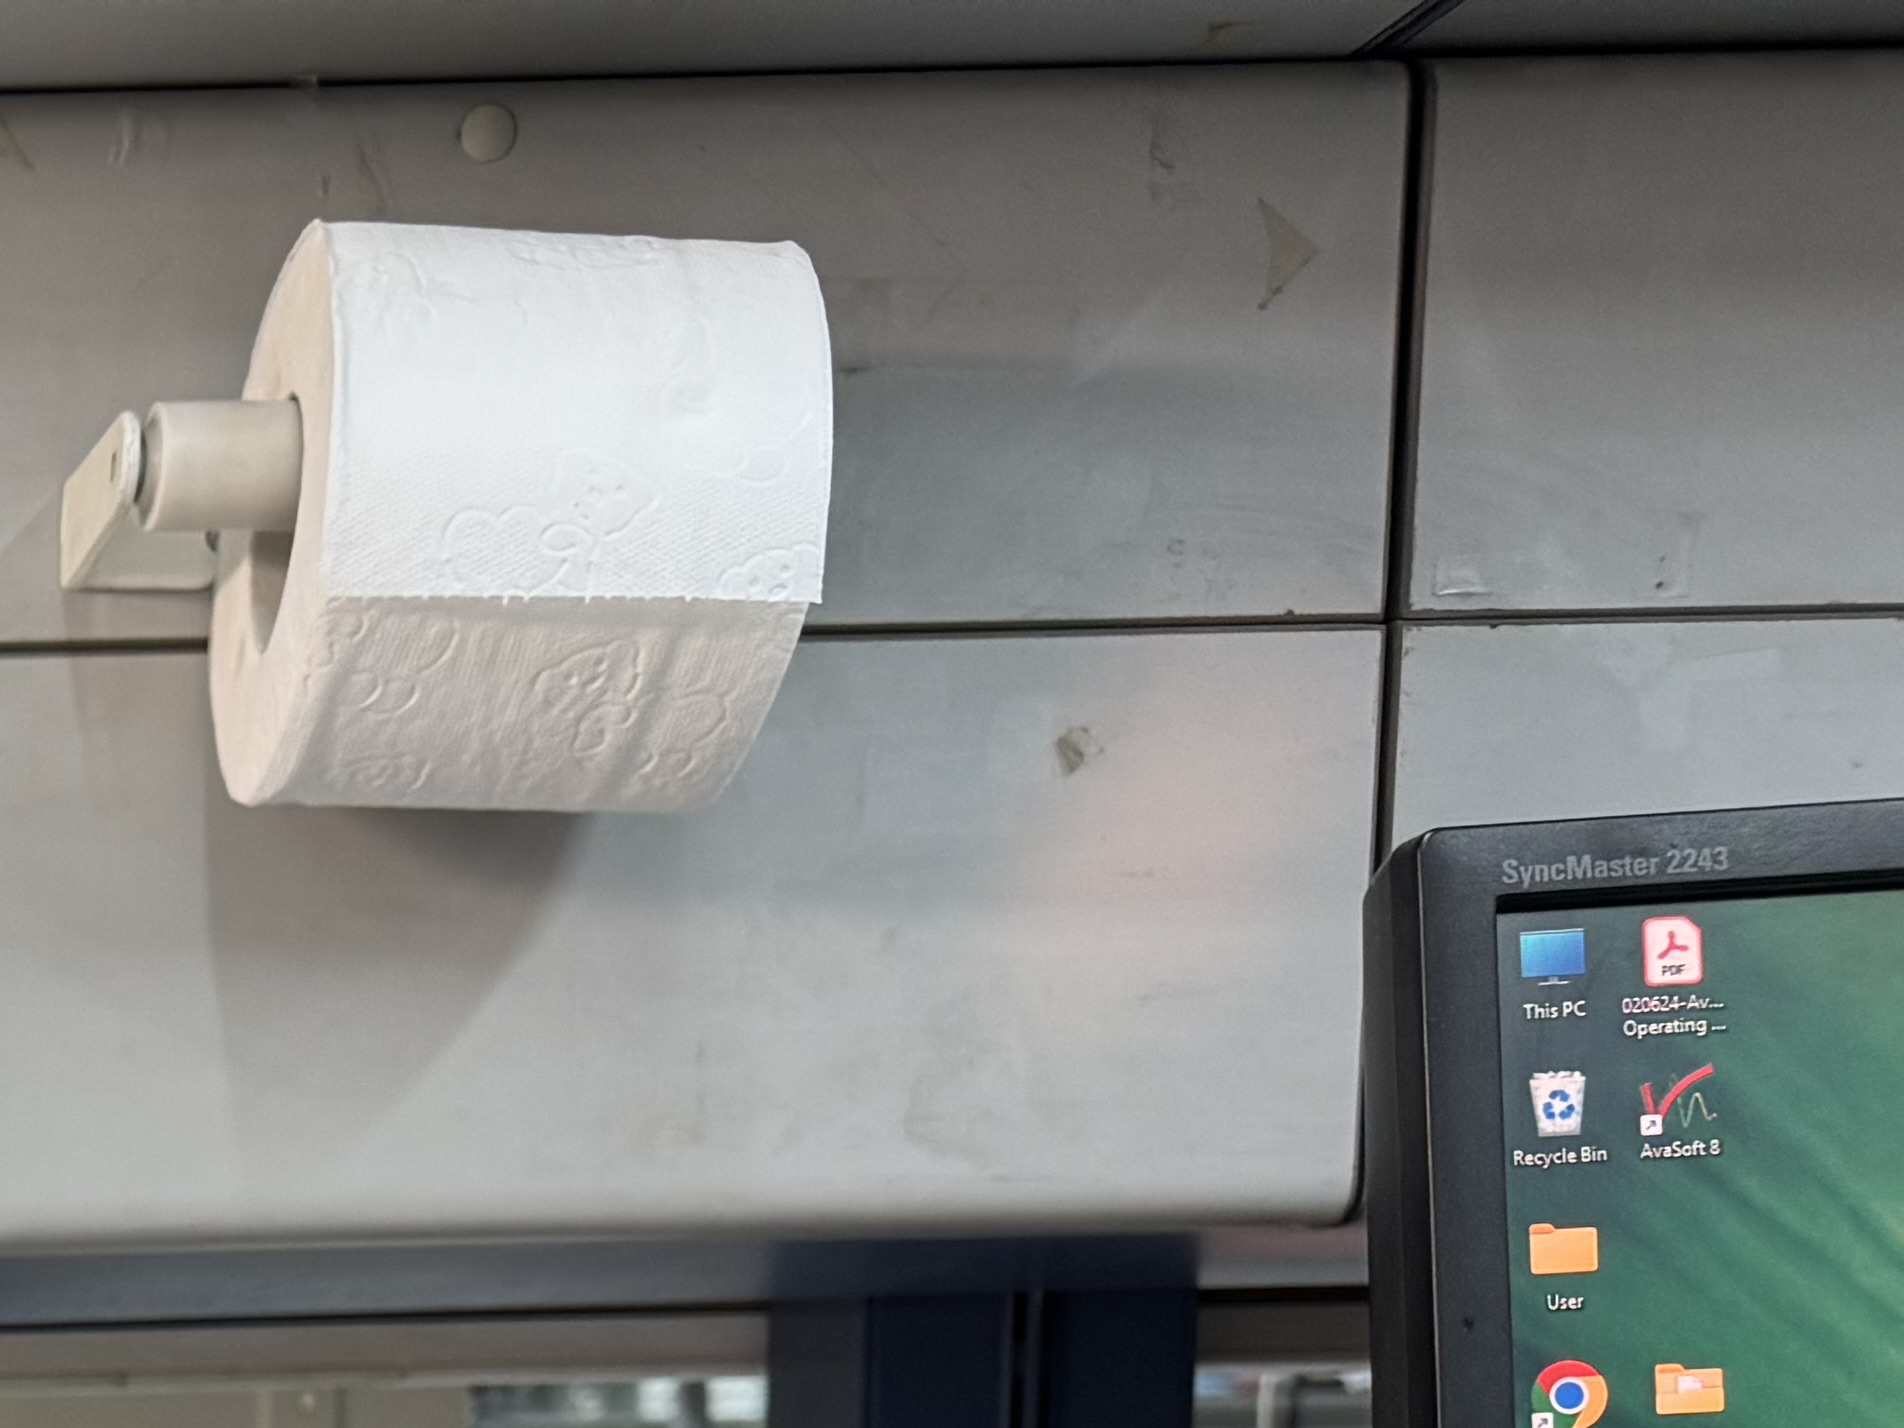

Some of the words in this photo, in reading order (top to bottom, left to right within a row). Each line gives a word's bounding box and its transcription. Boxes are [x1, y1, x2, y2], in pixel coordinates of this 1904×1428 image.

[1501, 854, 1659, 889] SyncMaster
[1666, 846, 1730, 875] 2243
[1661, 963, 1686, 977] PDF
[1523, 1003, 1559, 1020] This
[1563, 1001, 1587, 1018] PC
[1623, 1017, 1708, 1040] Operating
[1513, 1149, 1577, 1169] Recycle
[1581, 1146, 1608, 1162] Bin
[1640, 1140, 1706, 1160] AvaSoft
[1710, 1139, 1722, 1156] 8
[1547, 1294, 1585, 1311] User
